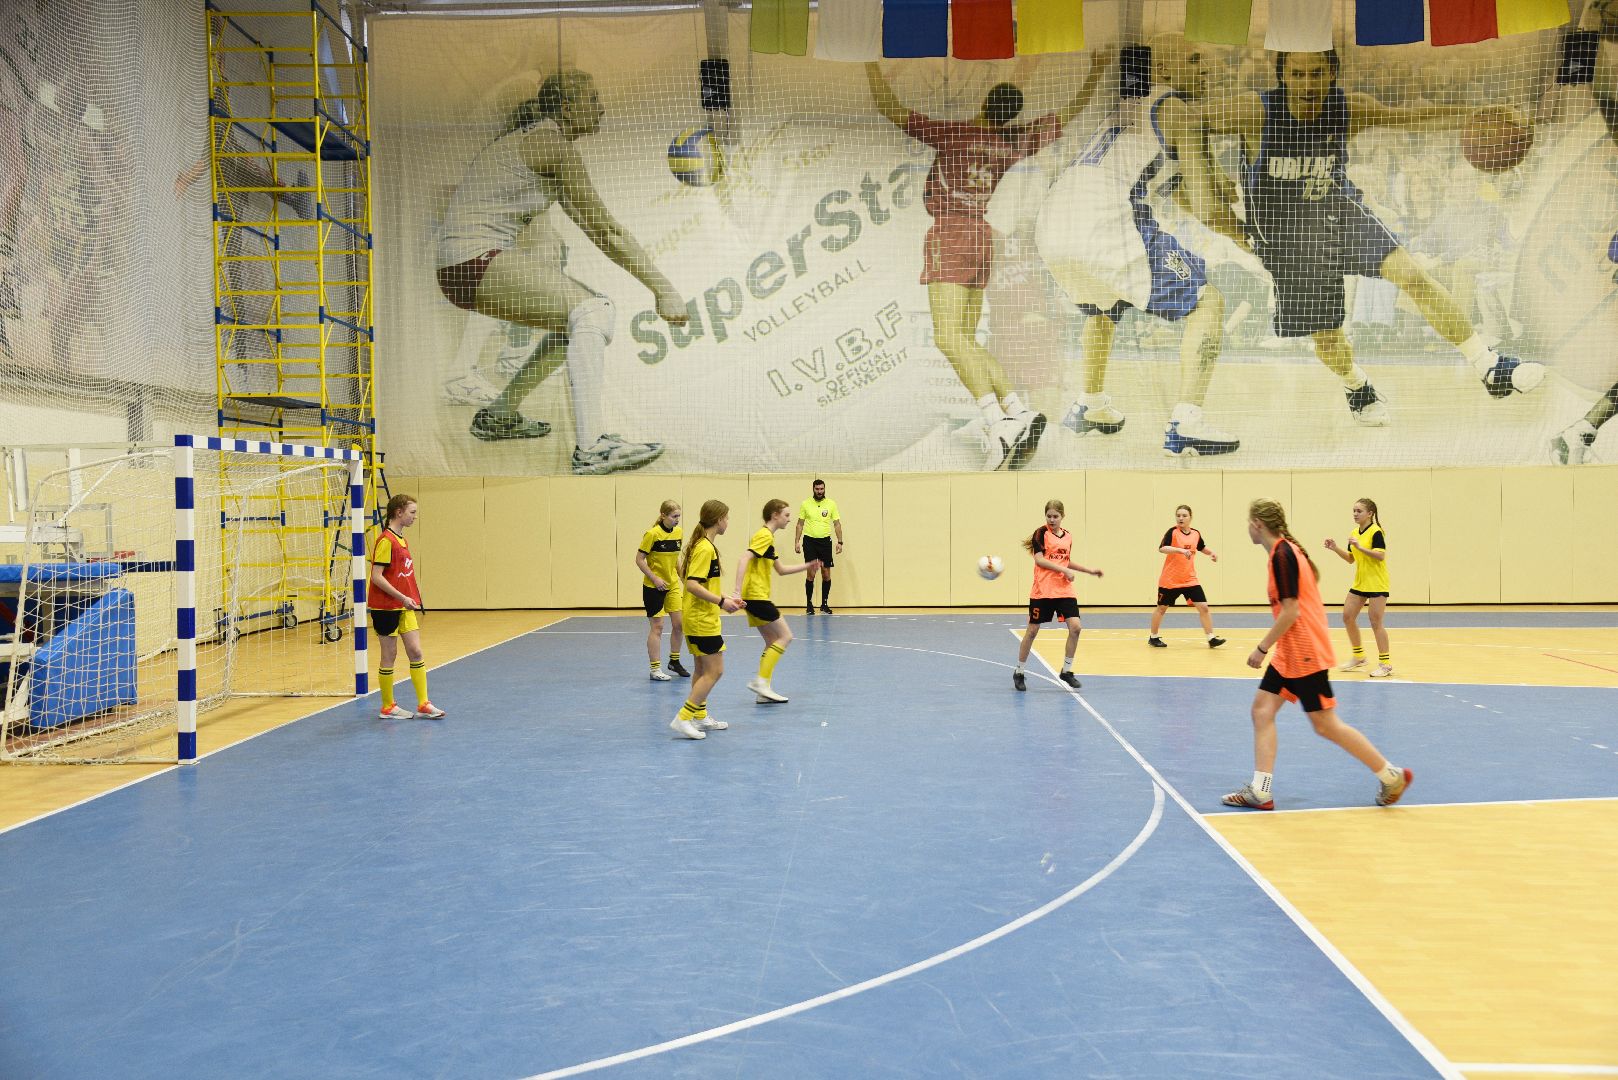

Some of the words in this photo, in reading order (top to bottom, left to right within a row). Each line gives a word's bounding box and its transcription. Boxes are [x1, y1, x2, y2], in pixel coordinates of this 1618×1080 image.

[1268, 154, 1335, 179] DALLAS
[743, 258, 873, 343] VOLLEYBALL
[825, 348, 894, 393] OFFICIAL
